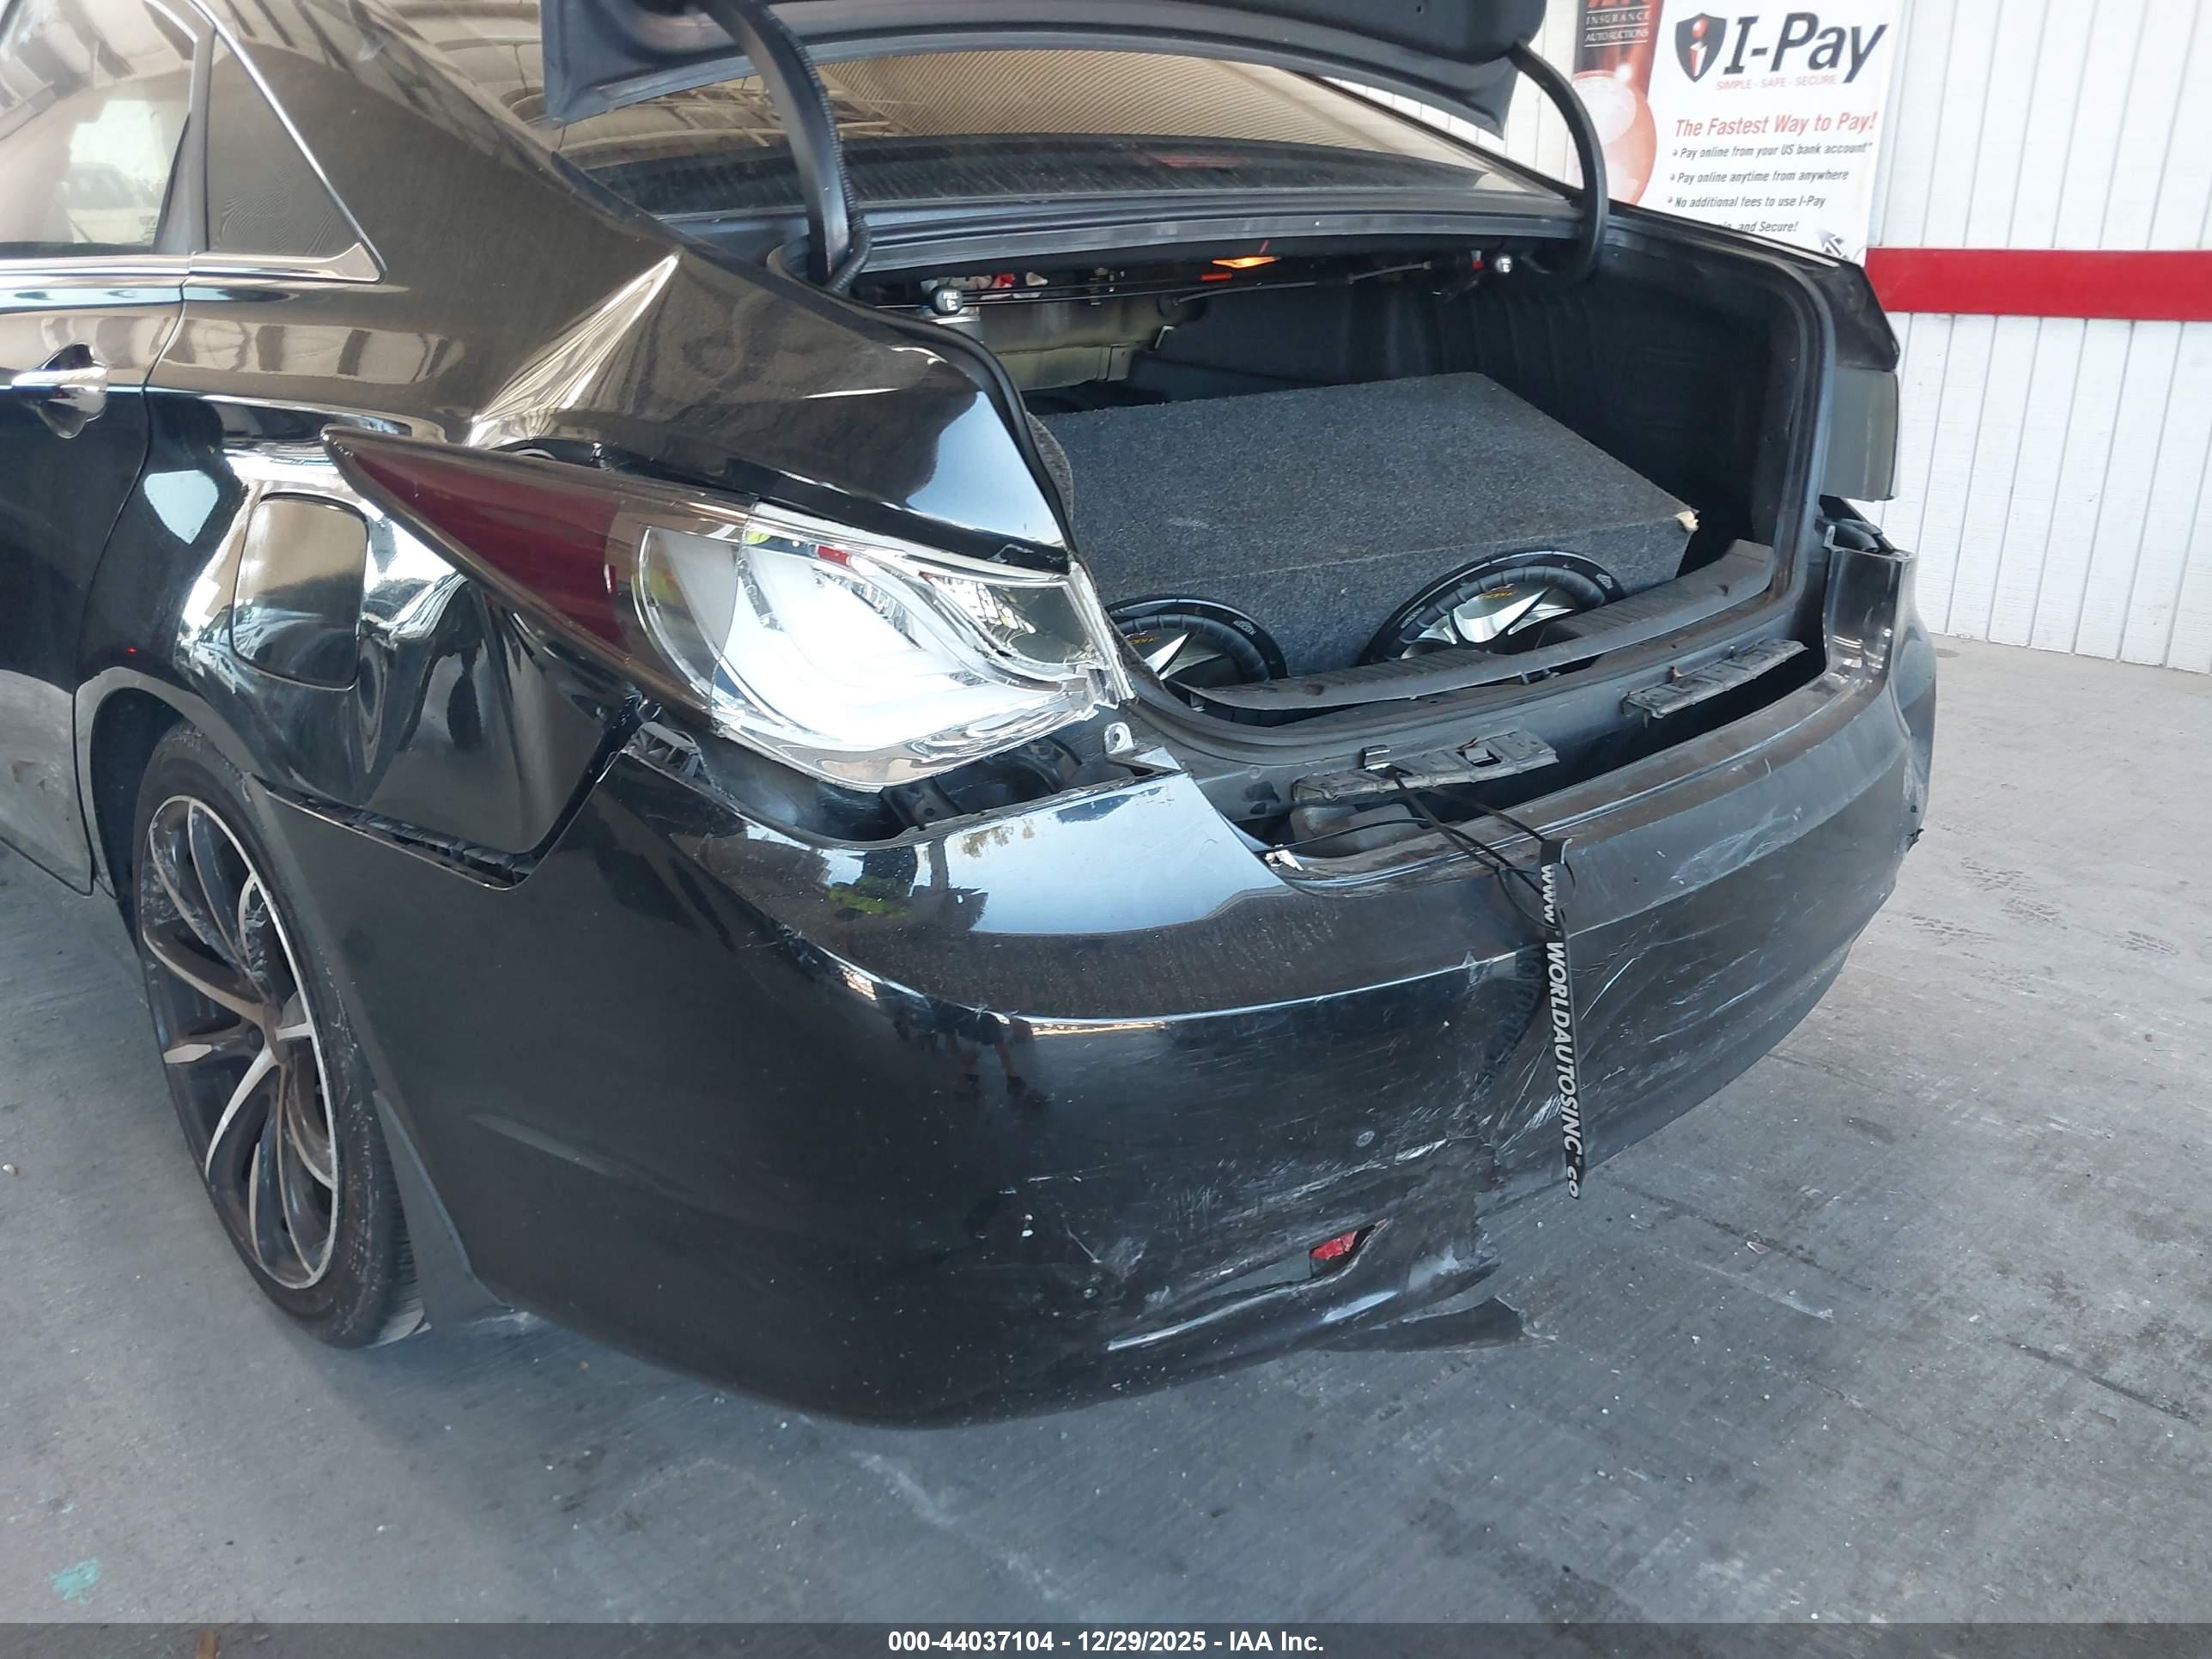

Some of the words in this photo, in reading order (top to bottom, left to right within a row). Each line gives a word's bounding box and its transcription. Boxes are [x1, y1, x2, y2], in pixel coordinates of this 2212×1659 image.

[1723, 12, 1888, 83] I-Pay
[1717, 79, 1753, 90] SIMPLE
[1759, 77, 1786, 88] SAFE
[1796, 75, 1836, 87] SECURE
[1676, 119, 1703, 137] The
[1707, 116, 1769, 136] Fastest
[1774, 114, 1809, 136] Way
[1815, 114, 1831, 131] to
[1837, 111, 1878, 134] Pay!
[1680, 148, 1698, 161] Pay
[1699, 146, 1729, 157] online
[1731, 145, 1753, 156] from
[1755, 148, 1778, 158] your
[1781, 144, 1795, 155] US
[1796, 143, 1820, 155] bank
[1677, 173, 1694, 185] Pay
[1697, 172, 1727, 182] online
[1729, 171, 1769, 184] anytime
[1771, 170, 1796, 181] from
[1797, 169, 1849, 183] anywhere
[1674, 197, 1687, 208] No
[1690, 196, 1737, 207] additional
[1741, 196, 1762, 206] fees
[1765, 197, 1776, 206] to
[1798, 195, 1826, 208] I-Pay
[1759, 221, 1799, 232] Secure!
